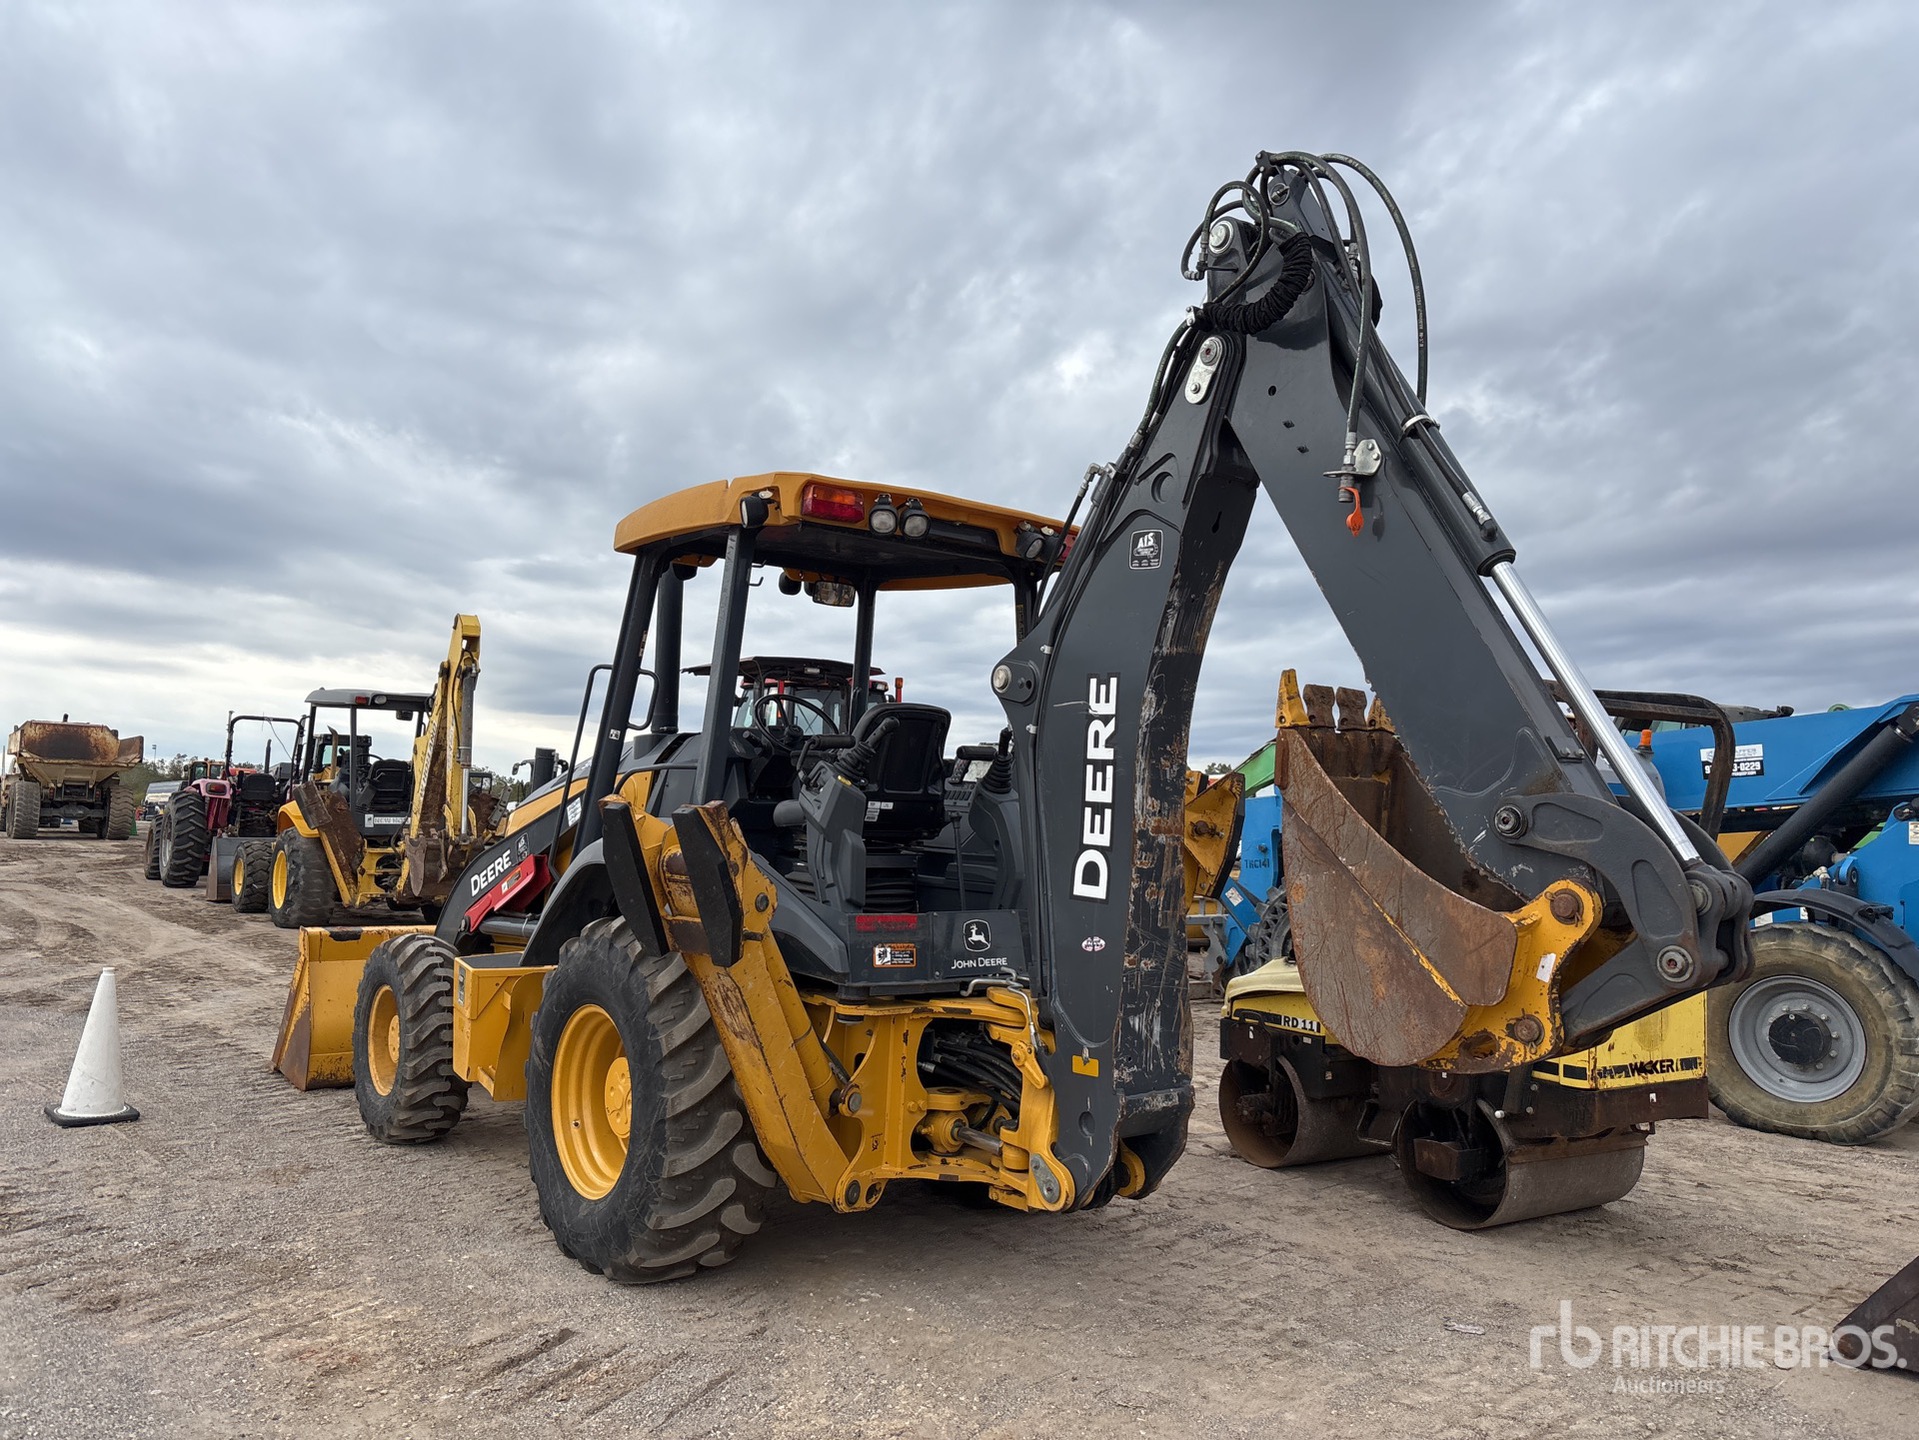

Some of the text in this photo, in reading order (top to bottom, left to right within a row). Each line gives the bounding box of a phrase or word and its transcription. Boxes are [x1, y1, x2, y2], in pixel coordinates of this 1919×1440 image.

[1072, 677, 1118, 900] DEERE
[470, 849, 512, 897] DEERE
[951, 957, 1008, 969] JOHN DEERE
[1283, 1015, 1315, 1032] RD 11
